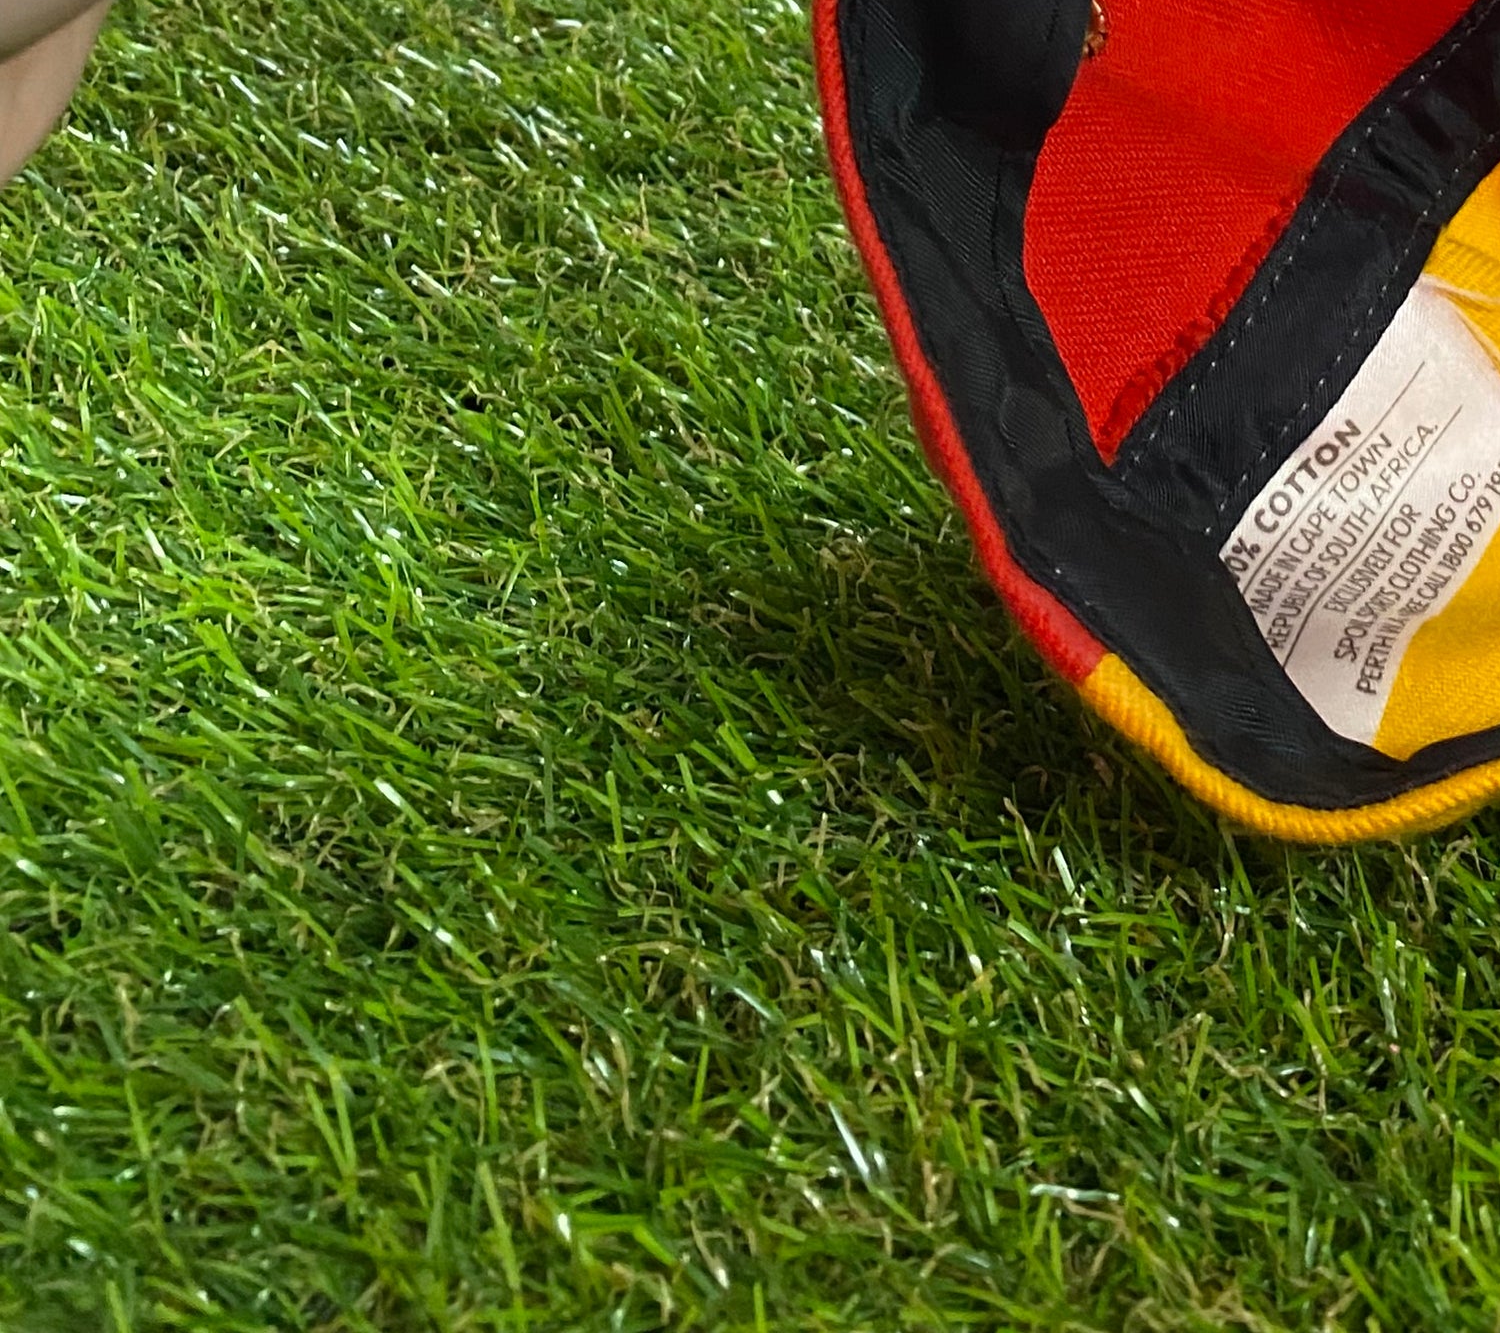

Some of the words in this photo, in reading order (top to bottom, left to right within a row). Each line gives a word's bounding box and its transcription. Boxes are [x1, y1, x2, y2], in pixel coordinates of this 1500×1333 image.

[1223, 536, 1262, 582] 0%
[1254, 418, 1362, 533] COTTON
[1251, 568, 1289, 615] MADE
[1273, 550, 1302, 573] IN
[1290, 500, 1336, 555] CAPE
[1328, 432, 1392, 504] TOWN
[1265, 579, 1319, 649] REPUBLIC
[1303, 561, 1331, 582] OF
[1317, 500, 1376, 566] SOUTH
[1370, 423, 1438, 506] AFRICA.
[1323, 541, 1394, 614] EXCLUSIVELY
[1382, 502, 1422, 548] FOR
[1388, 502, 1456, 591] CLOTHING
[1448, 472, 1482, 503] Co.
[1356, 634, 1397, 695] PERTH
[1417, 570, 1451, 600] CALL
[1437, 532, 1474, 573] 1800
[1465, 495, 1493, 534] 679
